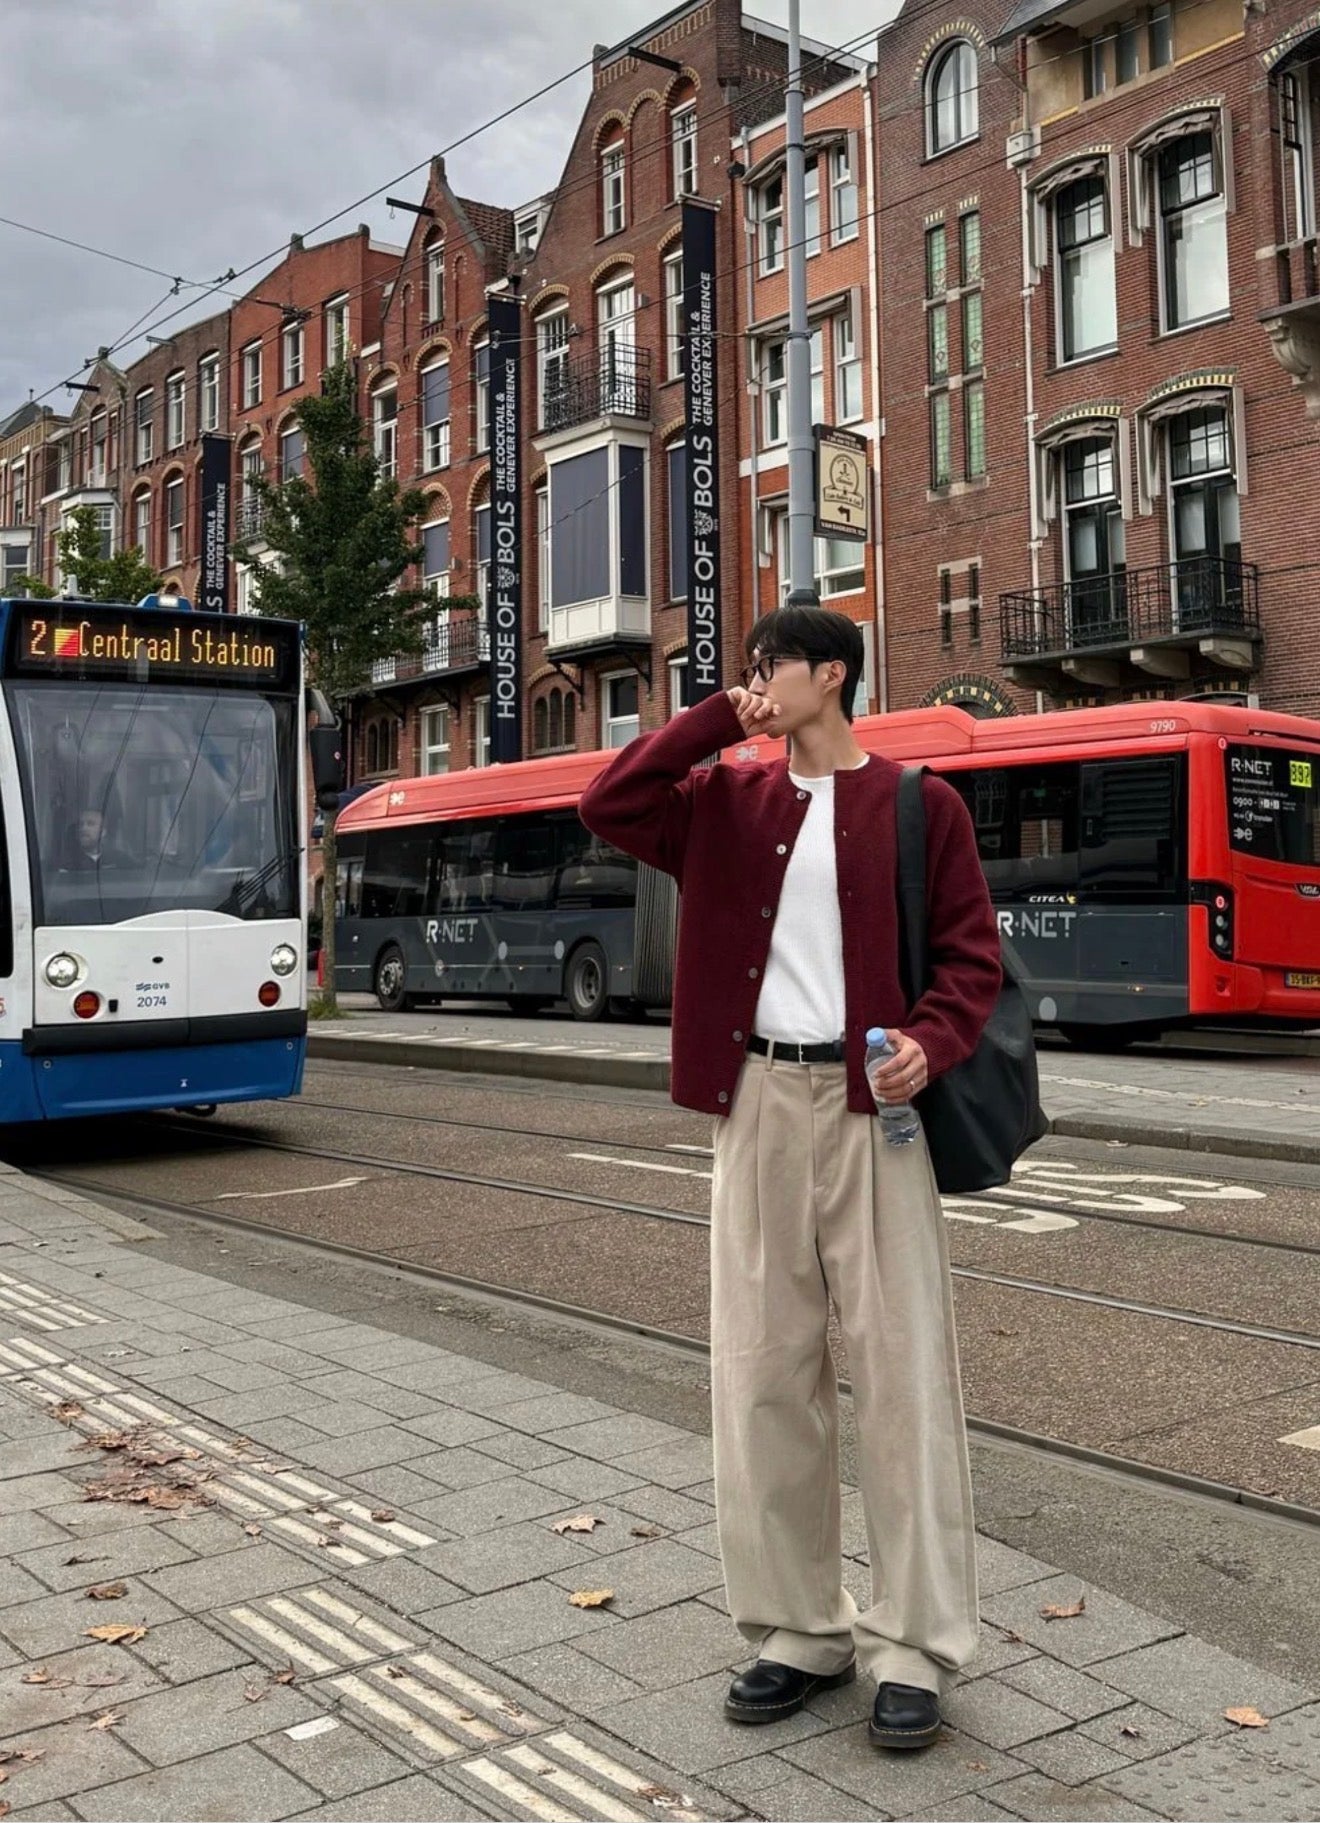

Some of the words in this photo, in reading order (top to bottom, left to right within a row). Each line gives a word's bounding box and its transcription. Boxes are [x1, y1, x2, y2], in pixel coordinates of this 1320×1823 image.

[690, 311, 700, 322] &
[701, 272, 712, 361] EXPERIENCE
[691, 325, 702, 394] COCKTAIL
[496, 392, 505, 402] &
[506, 358, 516, 434] EXPERIENCE
[692, 397, 702, 424] THE
[702, 363, 713, 426] GENEVER
[496, 403, 506, 464] COCKTAIL
[496, 469, 506, 491] THE
[506, 436, 516, 493] GENEVER
[693, 435, 713, 507] BOLS
[216, 483, 226, 542] EXPERIENCE
[496, 501, 515, 564] BOLS
[206, 521, 216, 569] COCKTAIL
[216, 545, 225, 590] GENEVER
[694, 540, 714, 581] OF
[206, 570, 215, 589] THE
[496, 592, 515, 628] OF
[30, 620, 47, 655] 2
[79, 621, 180, 662] Centraal
[191, 629, 275, 668] Station
[695, 586, 716, 684] HOUSE
[496, 633, 516, 719] HOUSE
[1150, 720, 1176, 732] 9790
[1028, 895, 1065, 903] CITEA
[137, 996, 167, 1008] 2074
